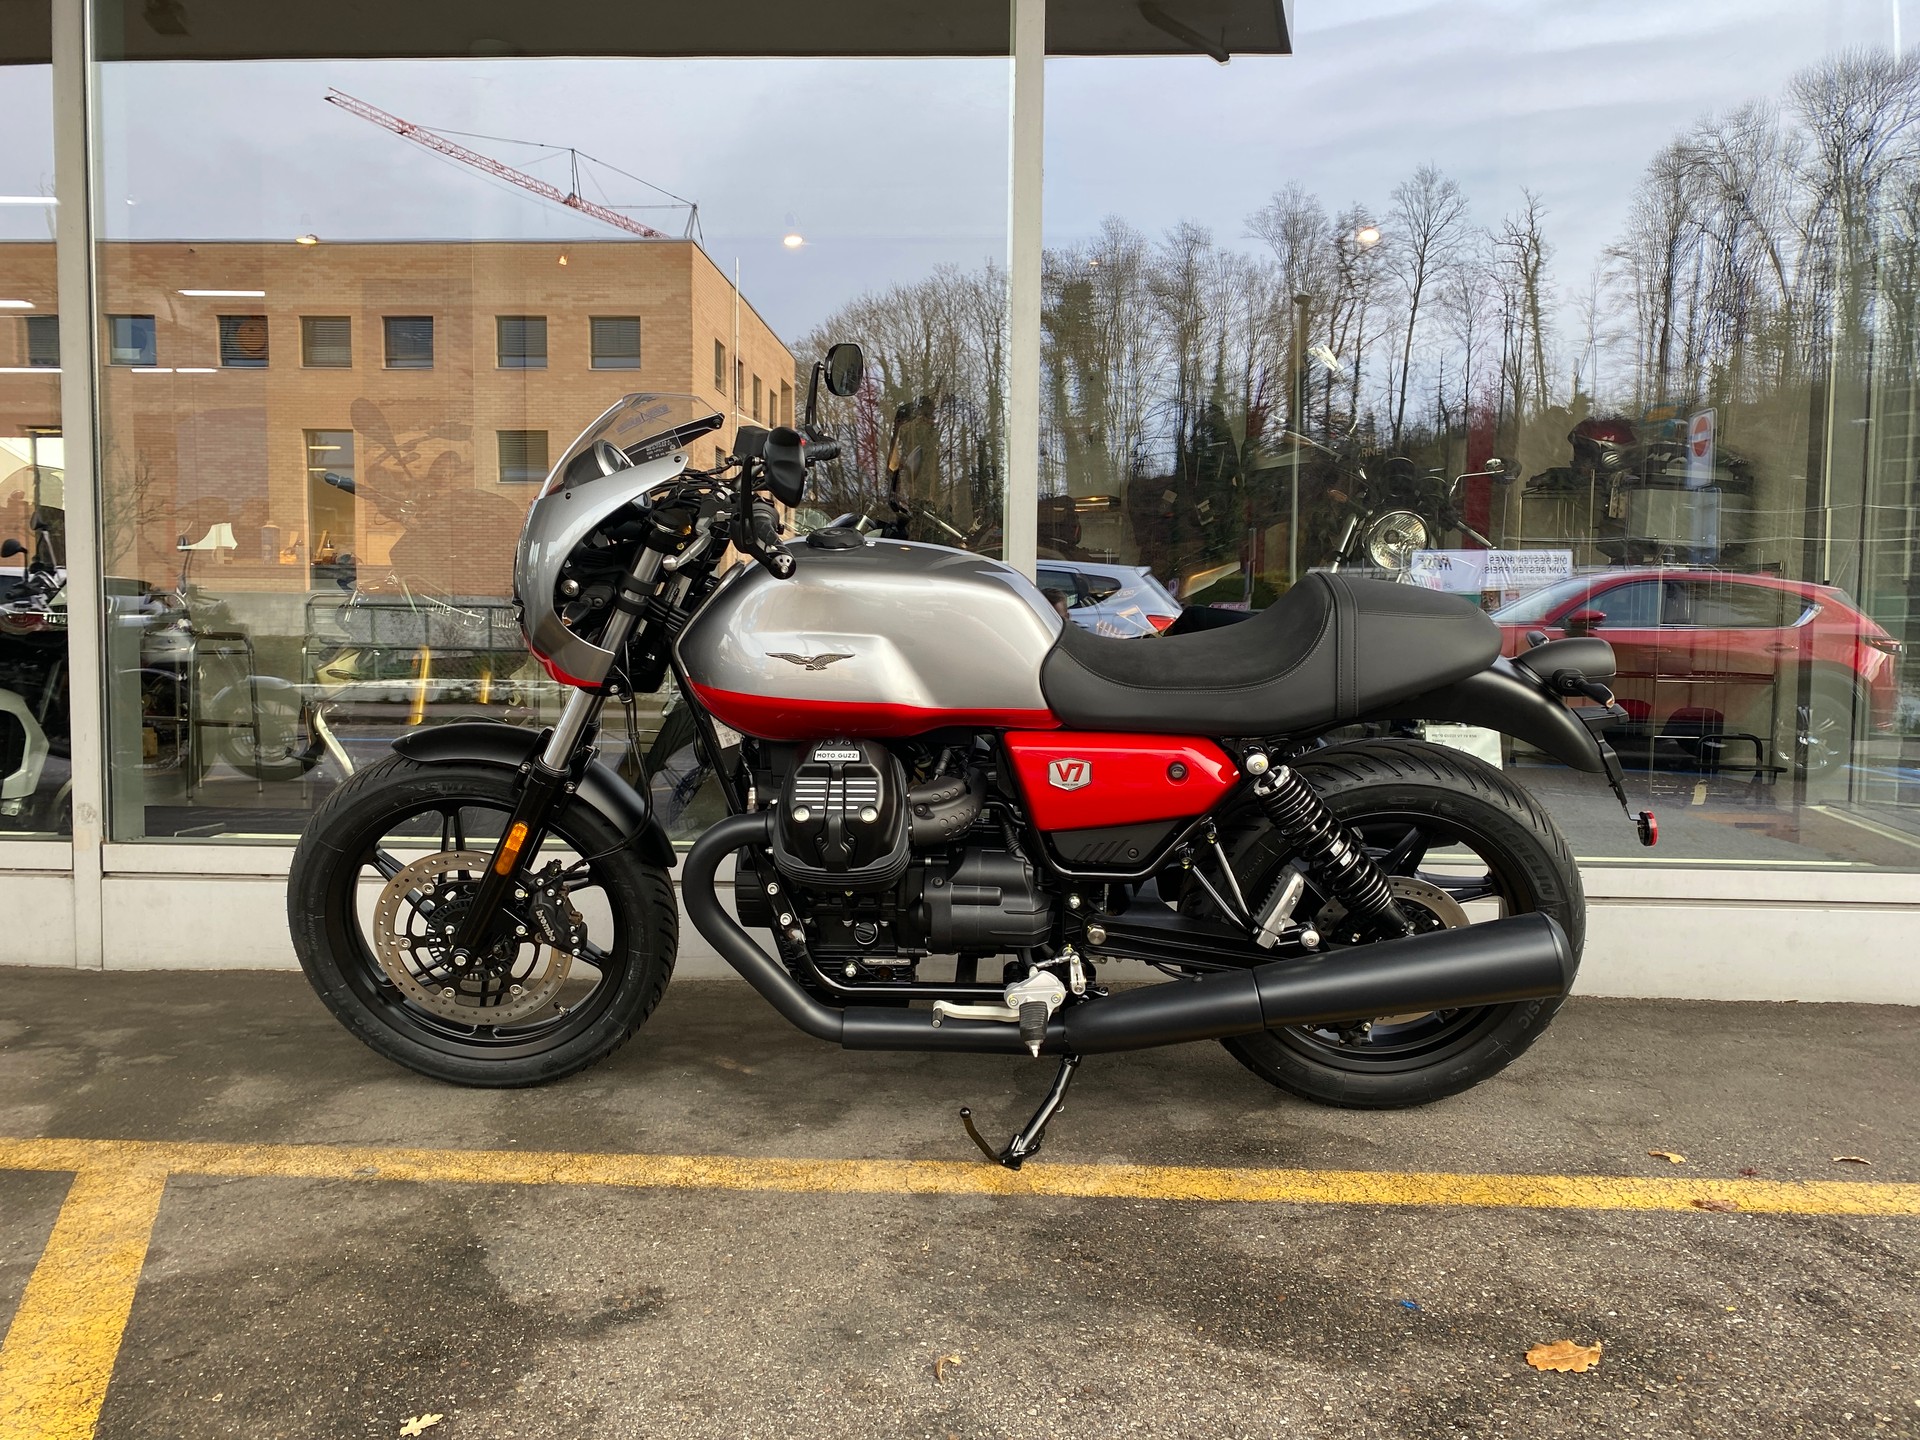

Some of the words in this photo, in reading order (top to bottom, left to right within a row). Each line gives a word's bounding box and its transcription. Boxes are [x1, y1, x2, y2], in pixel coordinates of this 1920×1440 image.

[1055, 762, 1085, 782] V7
[1480, 813, 1555, 897] MICHELIN
[535, 909, 556, 942] brembo
